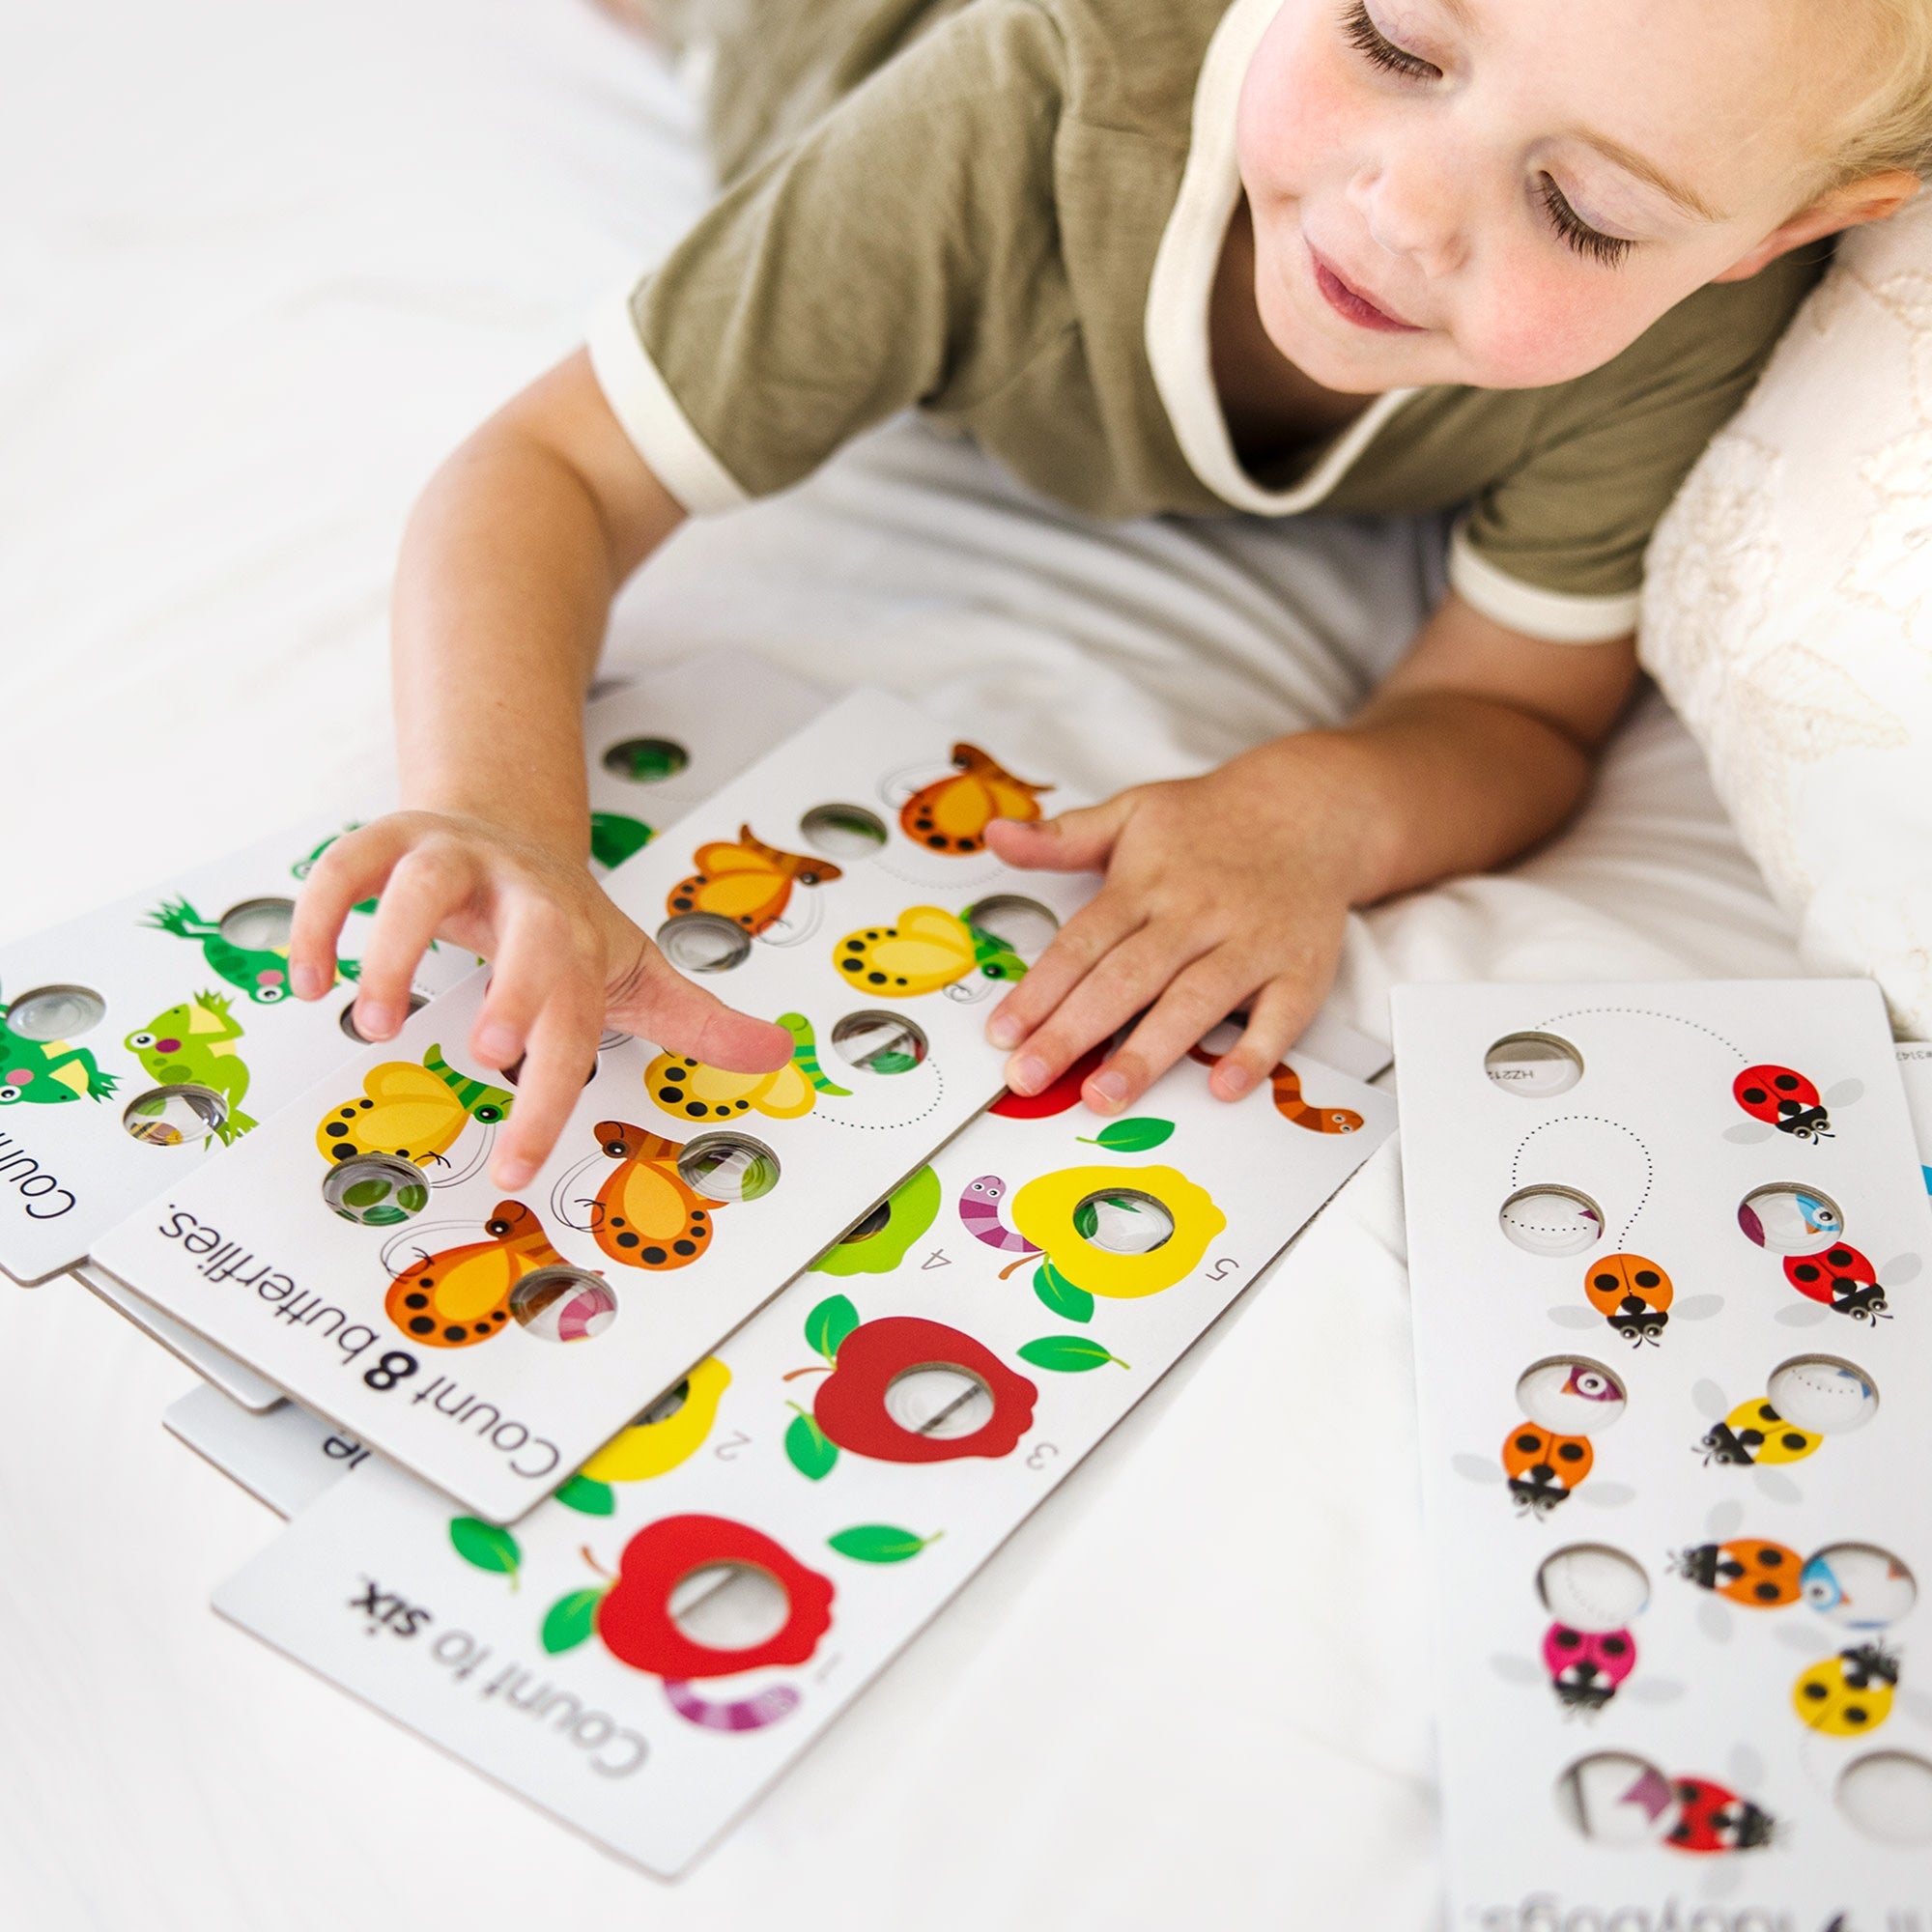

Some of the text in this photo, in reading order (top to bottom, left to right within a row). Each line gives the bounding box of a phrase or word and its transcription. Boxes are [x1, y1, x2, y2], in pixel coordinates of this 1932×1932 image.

[0, 1132, 77, 1219] Coun
[920, 1248, 952, 1272] 4
[1205, 1258, 1240, 1283] 5
[157, 1203, 561, 1481] Count 8 butterflies.
[714, 1430, 753, 1463] 2
[1025, 1442, 1059, 1471] 3
[348, 1579, 651, 1780] Count to six
